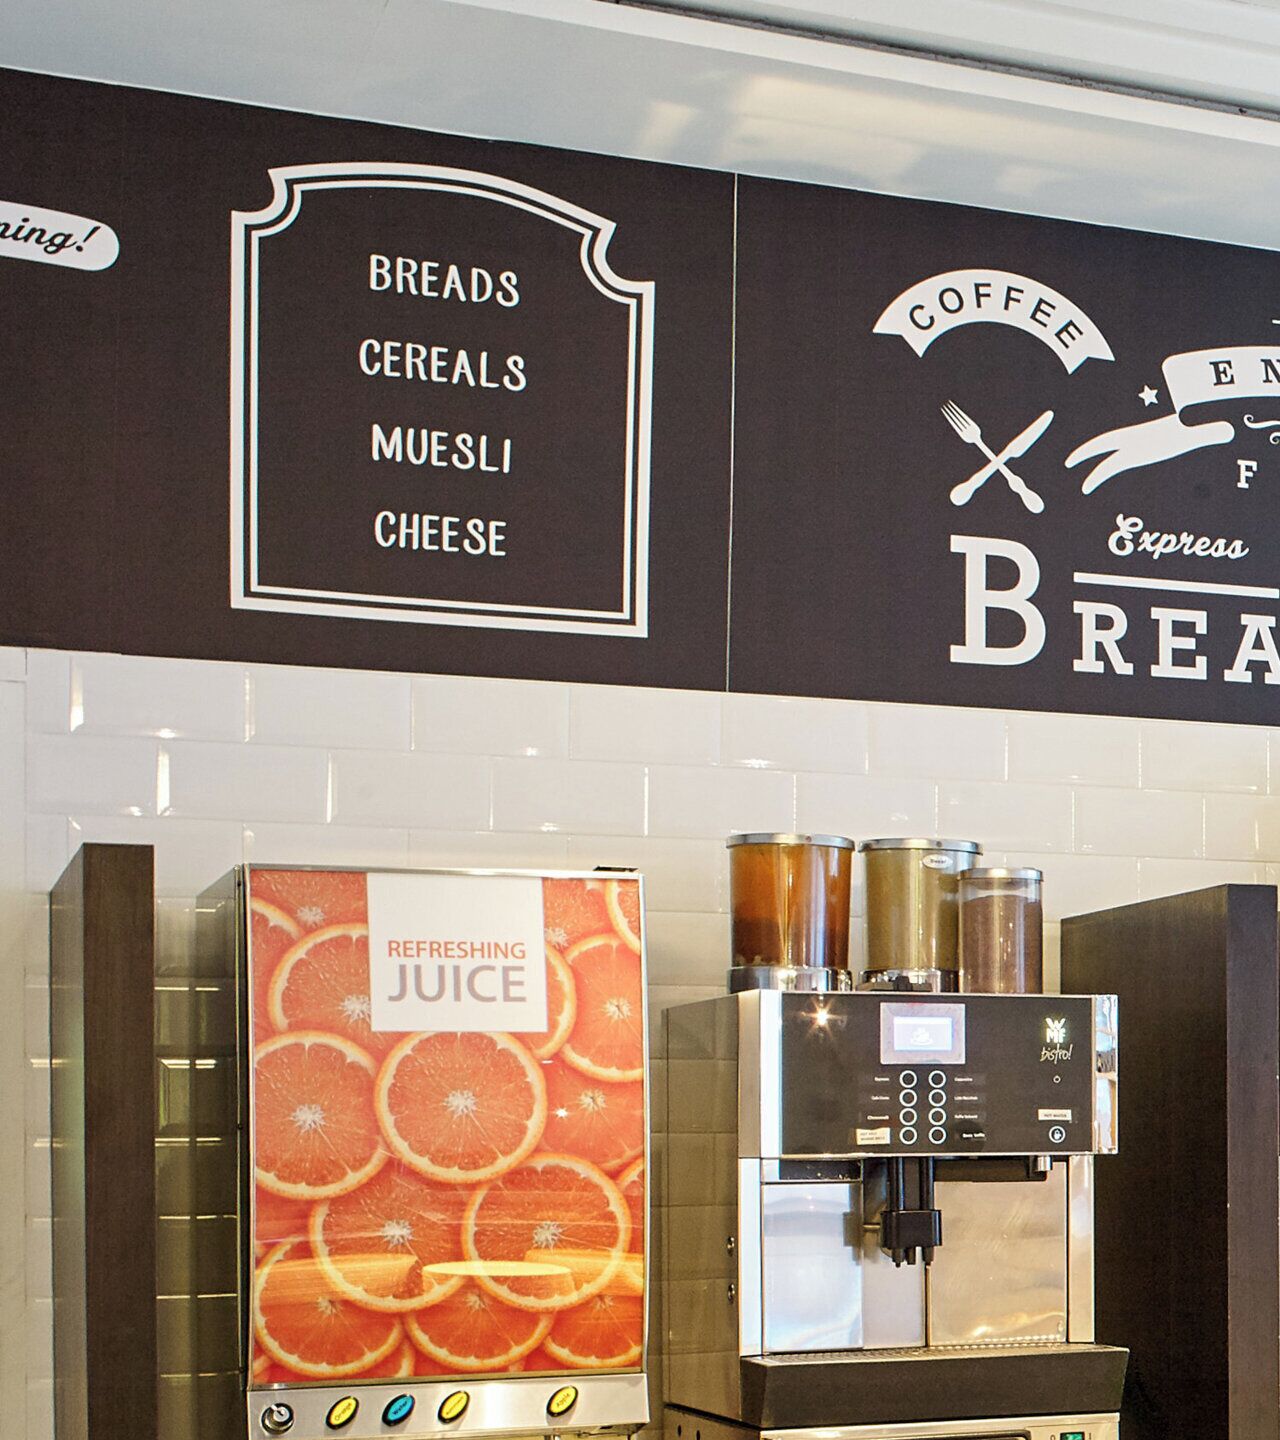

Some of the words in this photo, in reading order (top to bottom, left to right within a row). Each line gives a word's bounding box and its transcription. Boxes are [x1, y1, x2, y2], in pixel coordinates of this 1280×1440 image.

[369, 254, 520, 308] BREADS
[909, 282, 1084, 349] COFFEE
[359, 338, 527, 392] CEREALS
[371, 423, 511, 474] MUESLI
[374, 510, 507, 556] CHEESE
[1107, 513, 1250, 560] Express
[387, 939, 526, 960] REFRESHING
[387, 963, 527, 1003] JUICE
